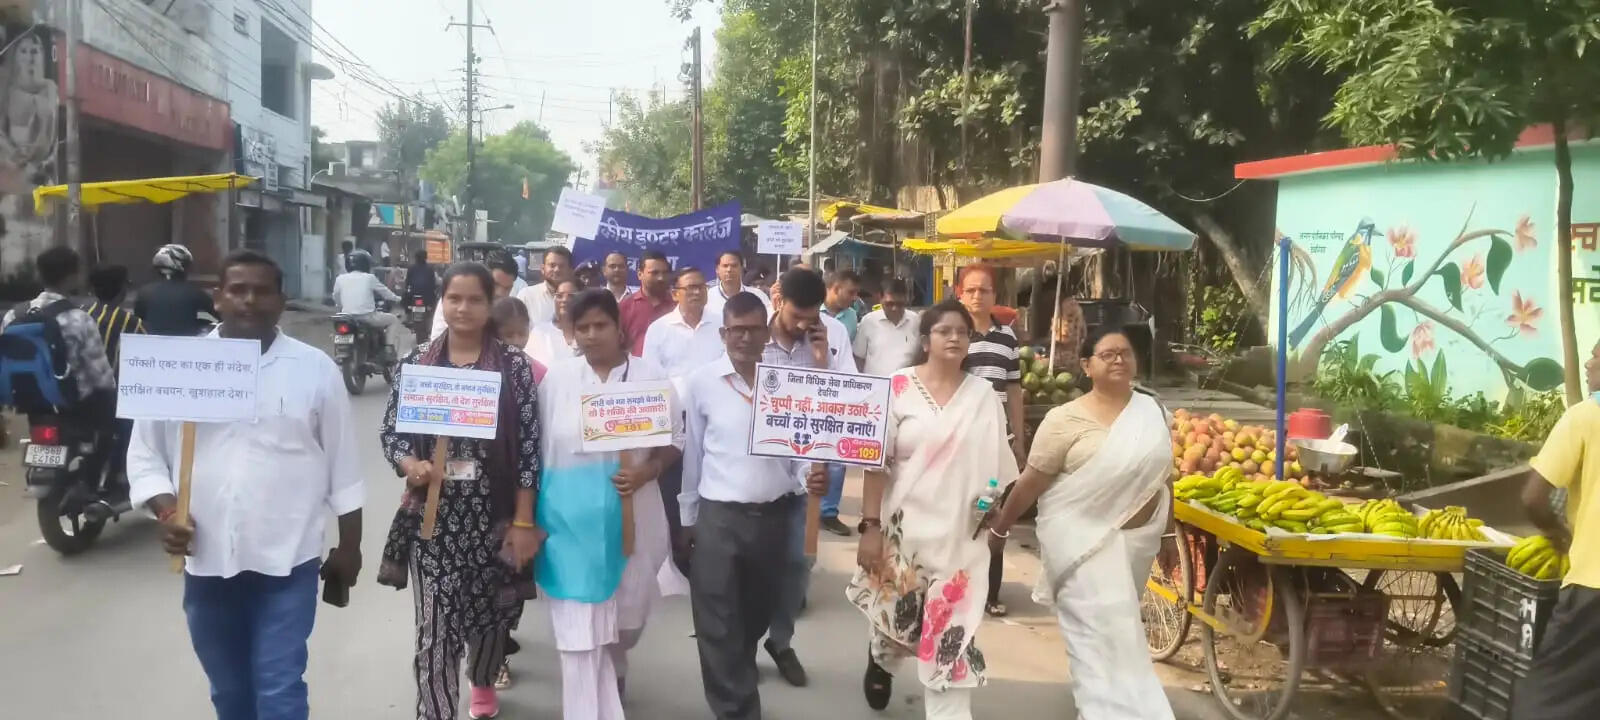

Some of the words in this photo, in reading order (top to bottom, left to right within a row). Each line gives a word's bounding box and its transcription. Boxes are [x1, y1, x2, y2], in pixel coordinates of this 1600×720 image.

[180, 360, 192, 369] का
[195, 361, 211, 372] एक
[214, 361, 224, 372] ही
[788, 372, 803, 383] जिला
[806, 374, 826, 386] विधिक
[828, 376, 840, 387] सेवा
[843, 378, 872, 391] प्राधिकरण
[120, 383, 152, 396] सुरक्षित
[771, 395, 792, 413] चुप्पी
[766, 412, 791, 429] बच्चों
[793, 414, 807, 430] को
[810, 415, 844, 435] सुरक्षित
[859, 446, 879, 459] 1091
